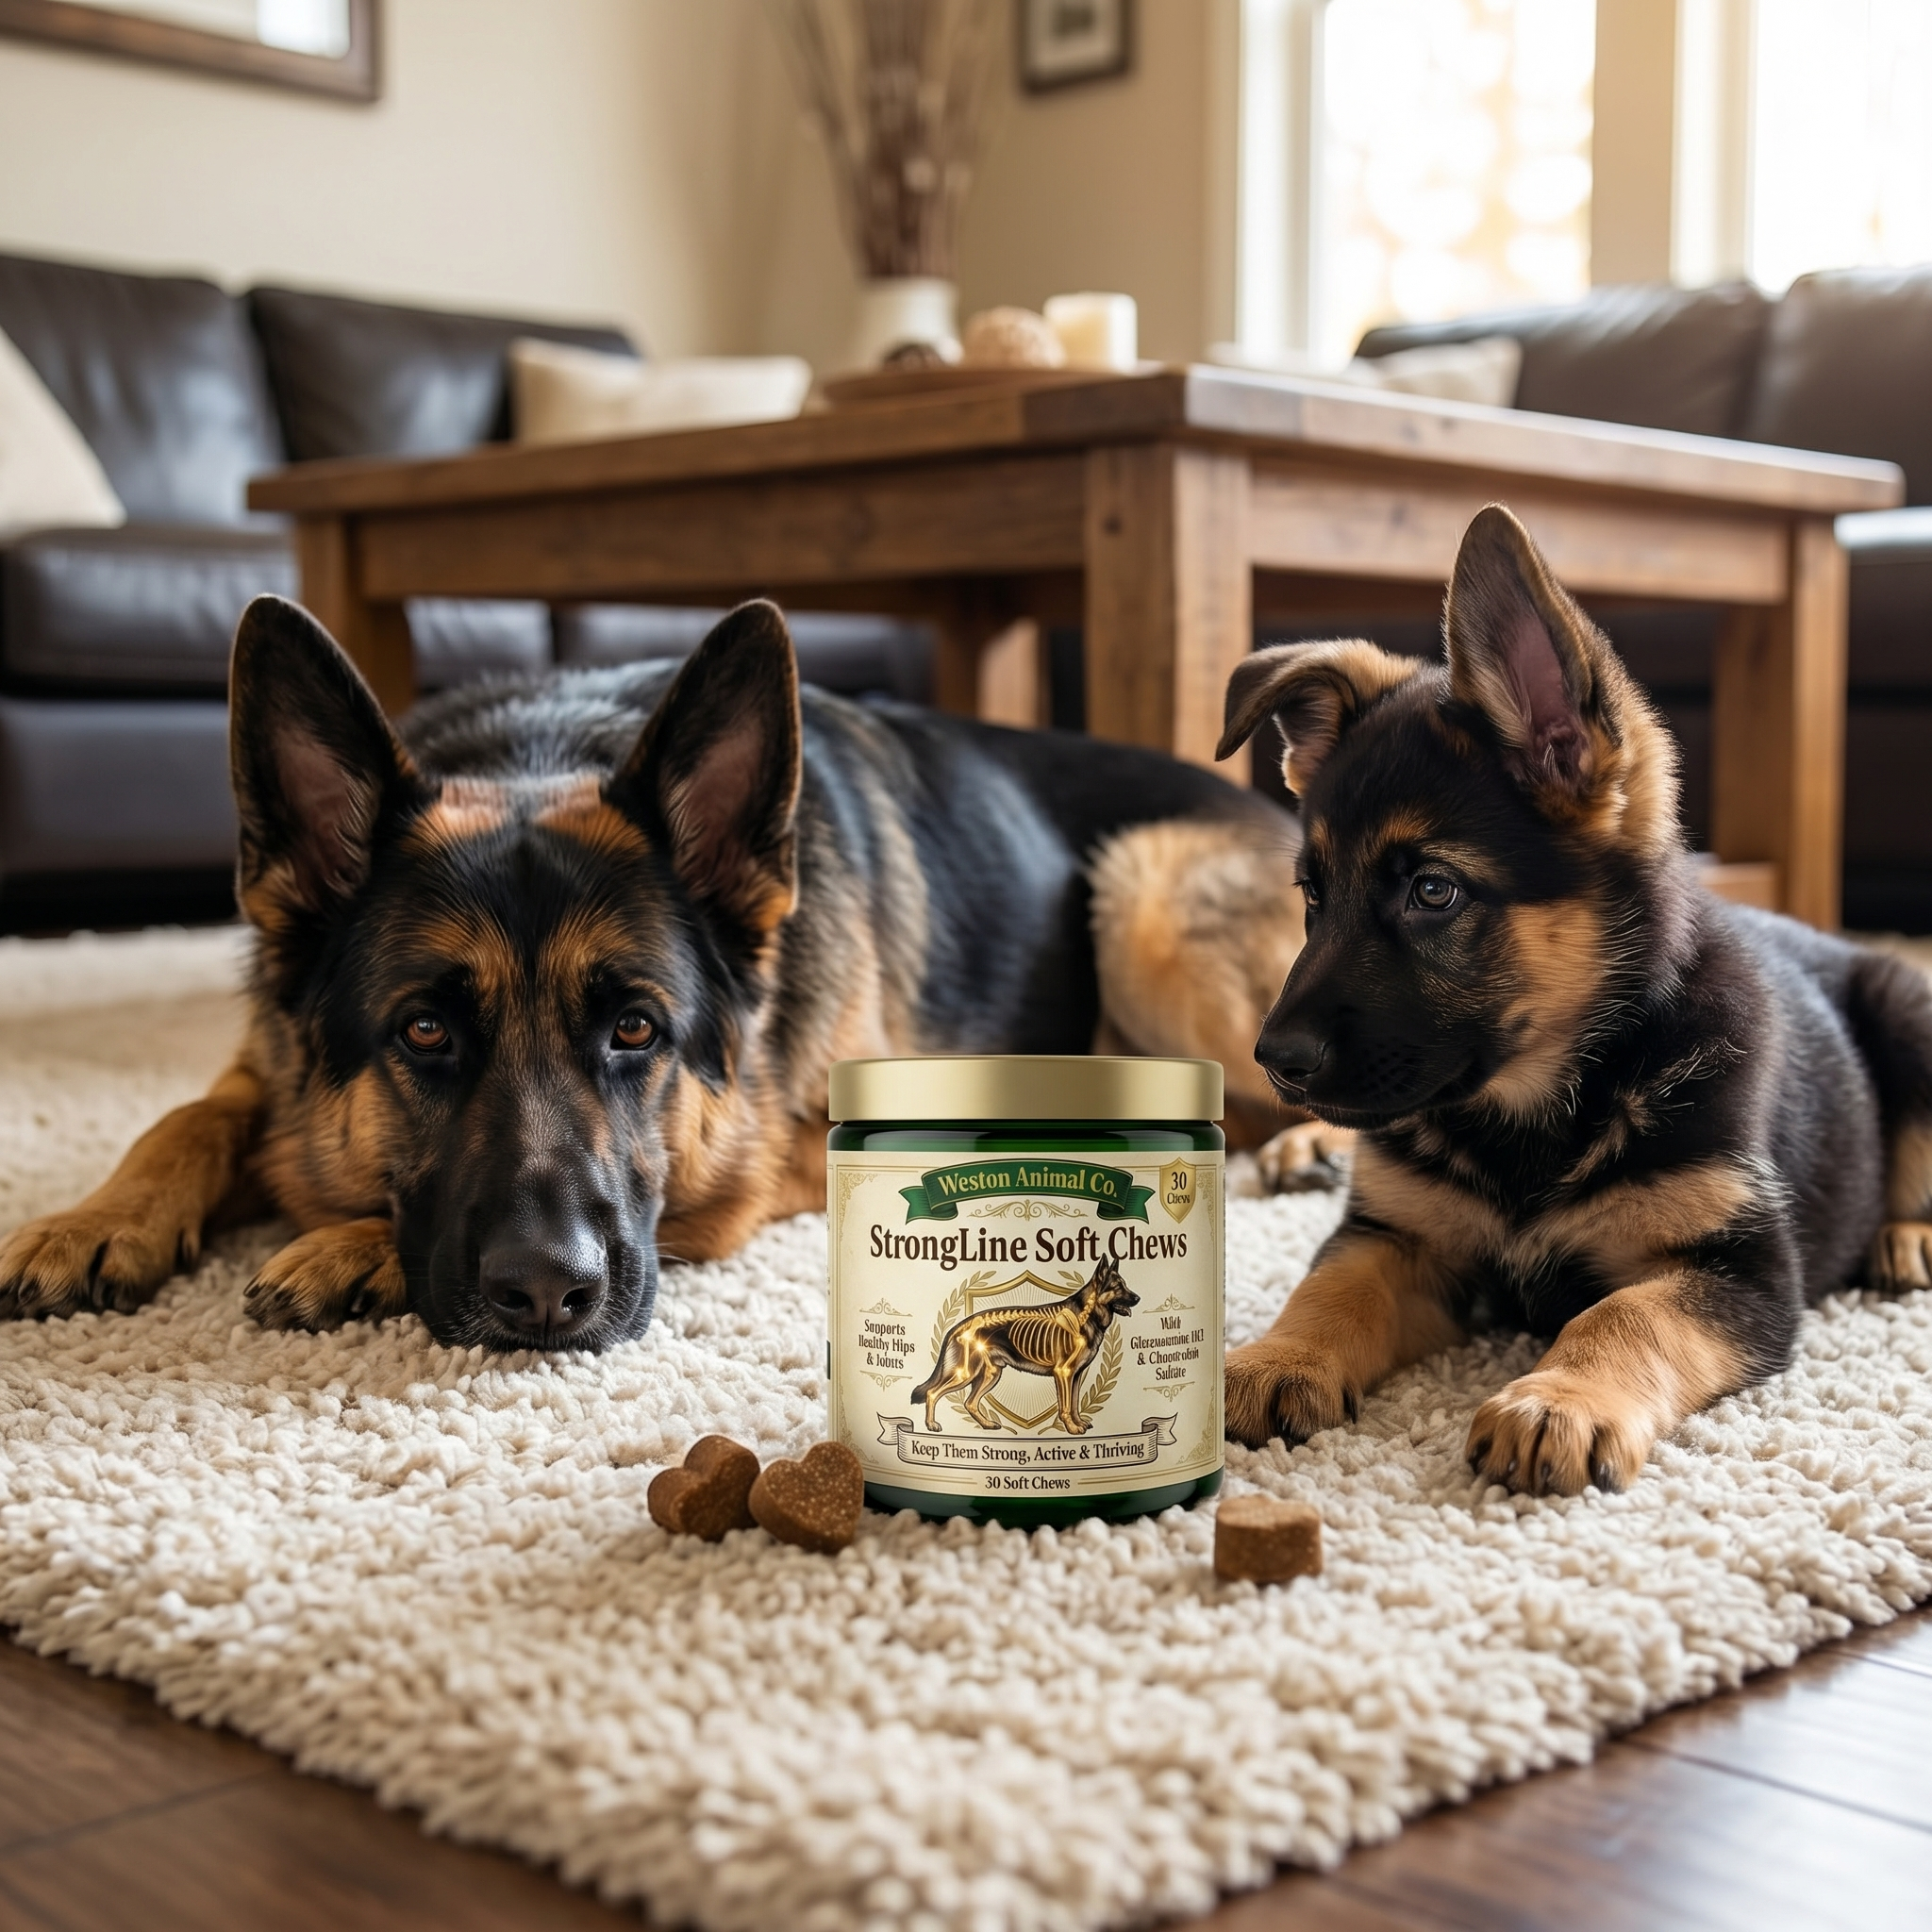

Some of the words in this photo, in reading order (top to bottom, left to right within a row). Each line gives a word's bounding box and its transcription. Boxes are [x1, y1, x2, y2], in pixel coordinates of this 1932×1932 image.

[938, 1172, 1010, 1196] Weston
[1015, 1166, 1085, 1190] Animal
[1090, 1173, 1118, 1198] Co.
[1171, 1172, 1188, 1191] 30
[871, 1224, 1028, 1271] StrongLine
[1036, 1226, 1100, 1262] Soft
[1108, 1225, 1187, 1260] Chews
[892, 1338, 915, 1357] Hips
[866, 1352, 874, 1365] &
[1137, 1352, 1146, 1366] &
[911, 1441, 940, 1460] Keep
[942, 1443, 978, 1459] Them
[982, 1445, 1031, 1466] Strong,
[1034, 1446, 1076, 1461] Active
[1079, 1444, 1091, 1459] &
[1093, 1441, 1145, 1458] Thriving
[985, 1476, 1000, 1490] 30
[1003, 1475, 1030, 1490] Soft
[1032, 1476, 1071, 1490] Chews
